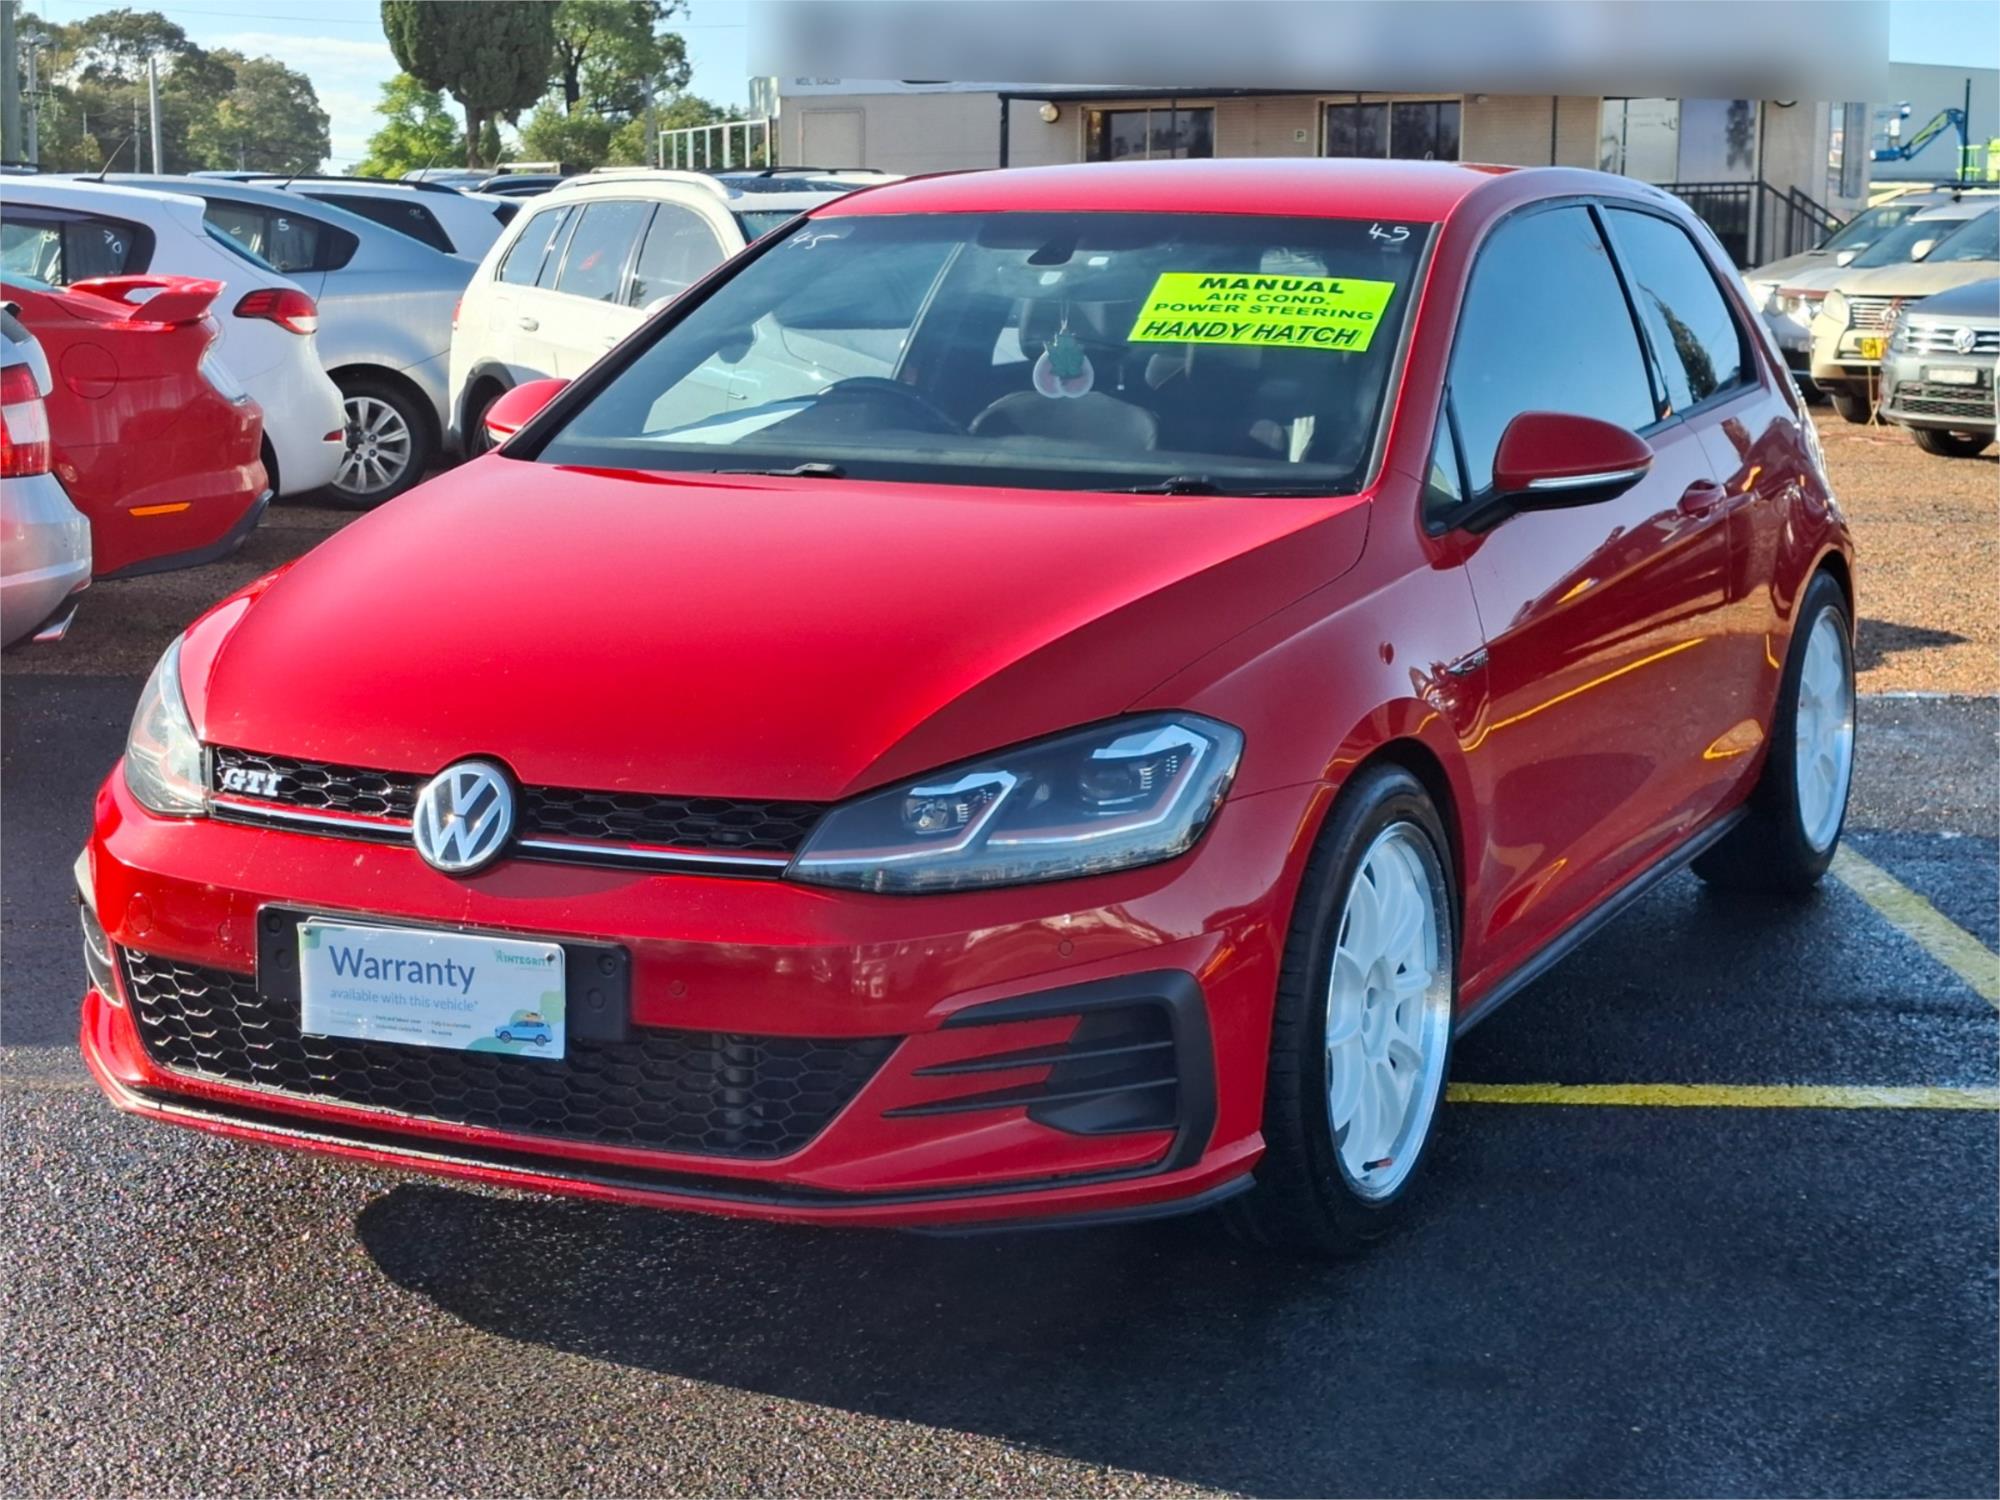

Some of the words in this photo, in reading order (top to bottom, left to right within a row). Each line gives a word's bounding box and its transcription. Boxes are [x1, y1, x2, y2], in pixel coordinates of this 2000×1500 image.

[1368, 222, 1411, 242] 45
[1199, 277, 1345, 294] MANUAL
[1205, 292, 1248, 302] AIR
[1256, 294, 1331, 306] COND.
[1153, 303, 1240, 314] POWER
[1248, 304, 1374, 321] STEERING
[1141, 320, 1252, 340] HANDY
[1251, 323, 1362, 346] HATCH
[224, 767, 282, 797] GTI
[328, 945, 476, 995] Warranty
[330, 987, 379, 1003] available
[381, 991, 407, 1005] with
[409, 993, 431, 1009] this
